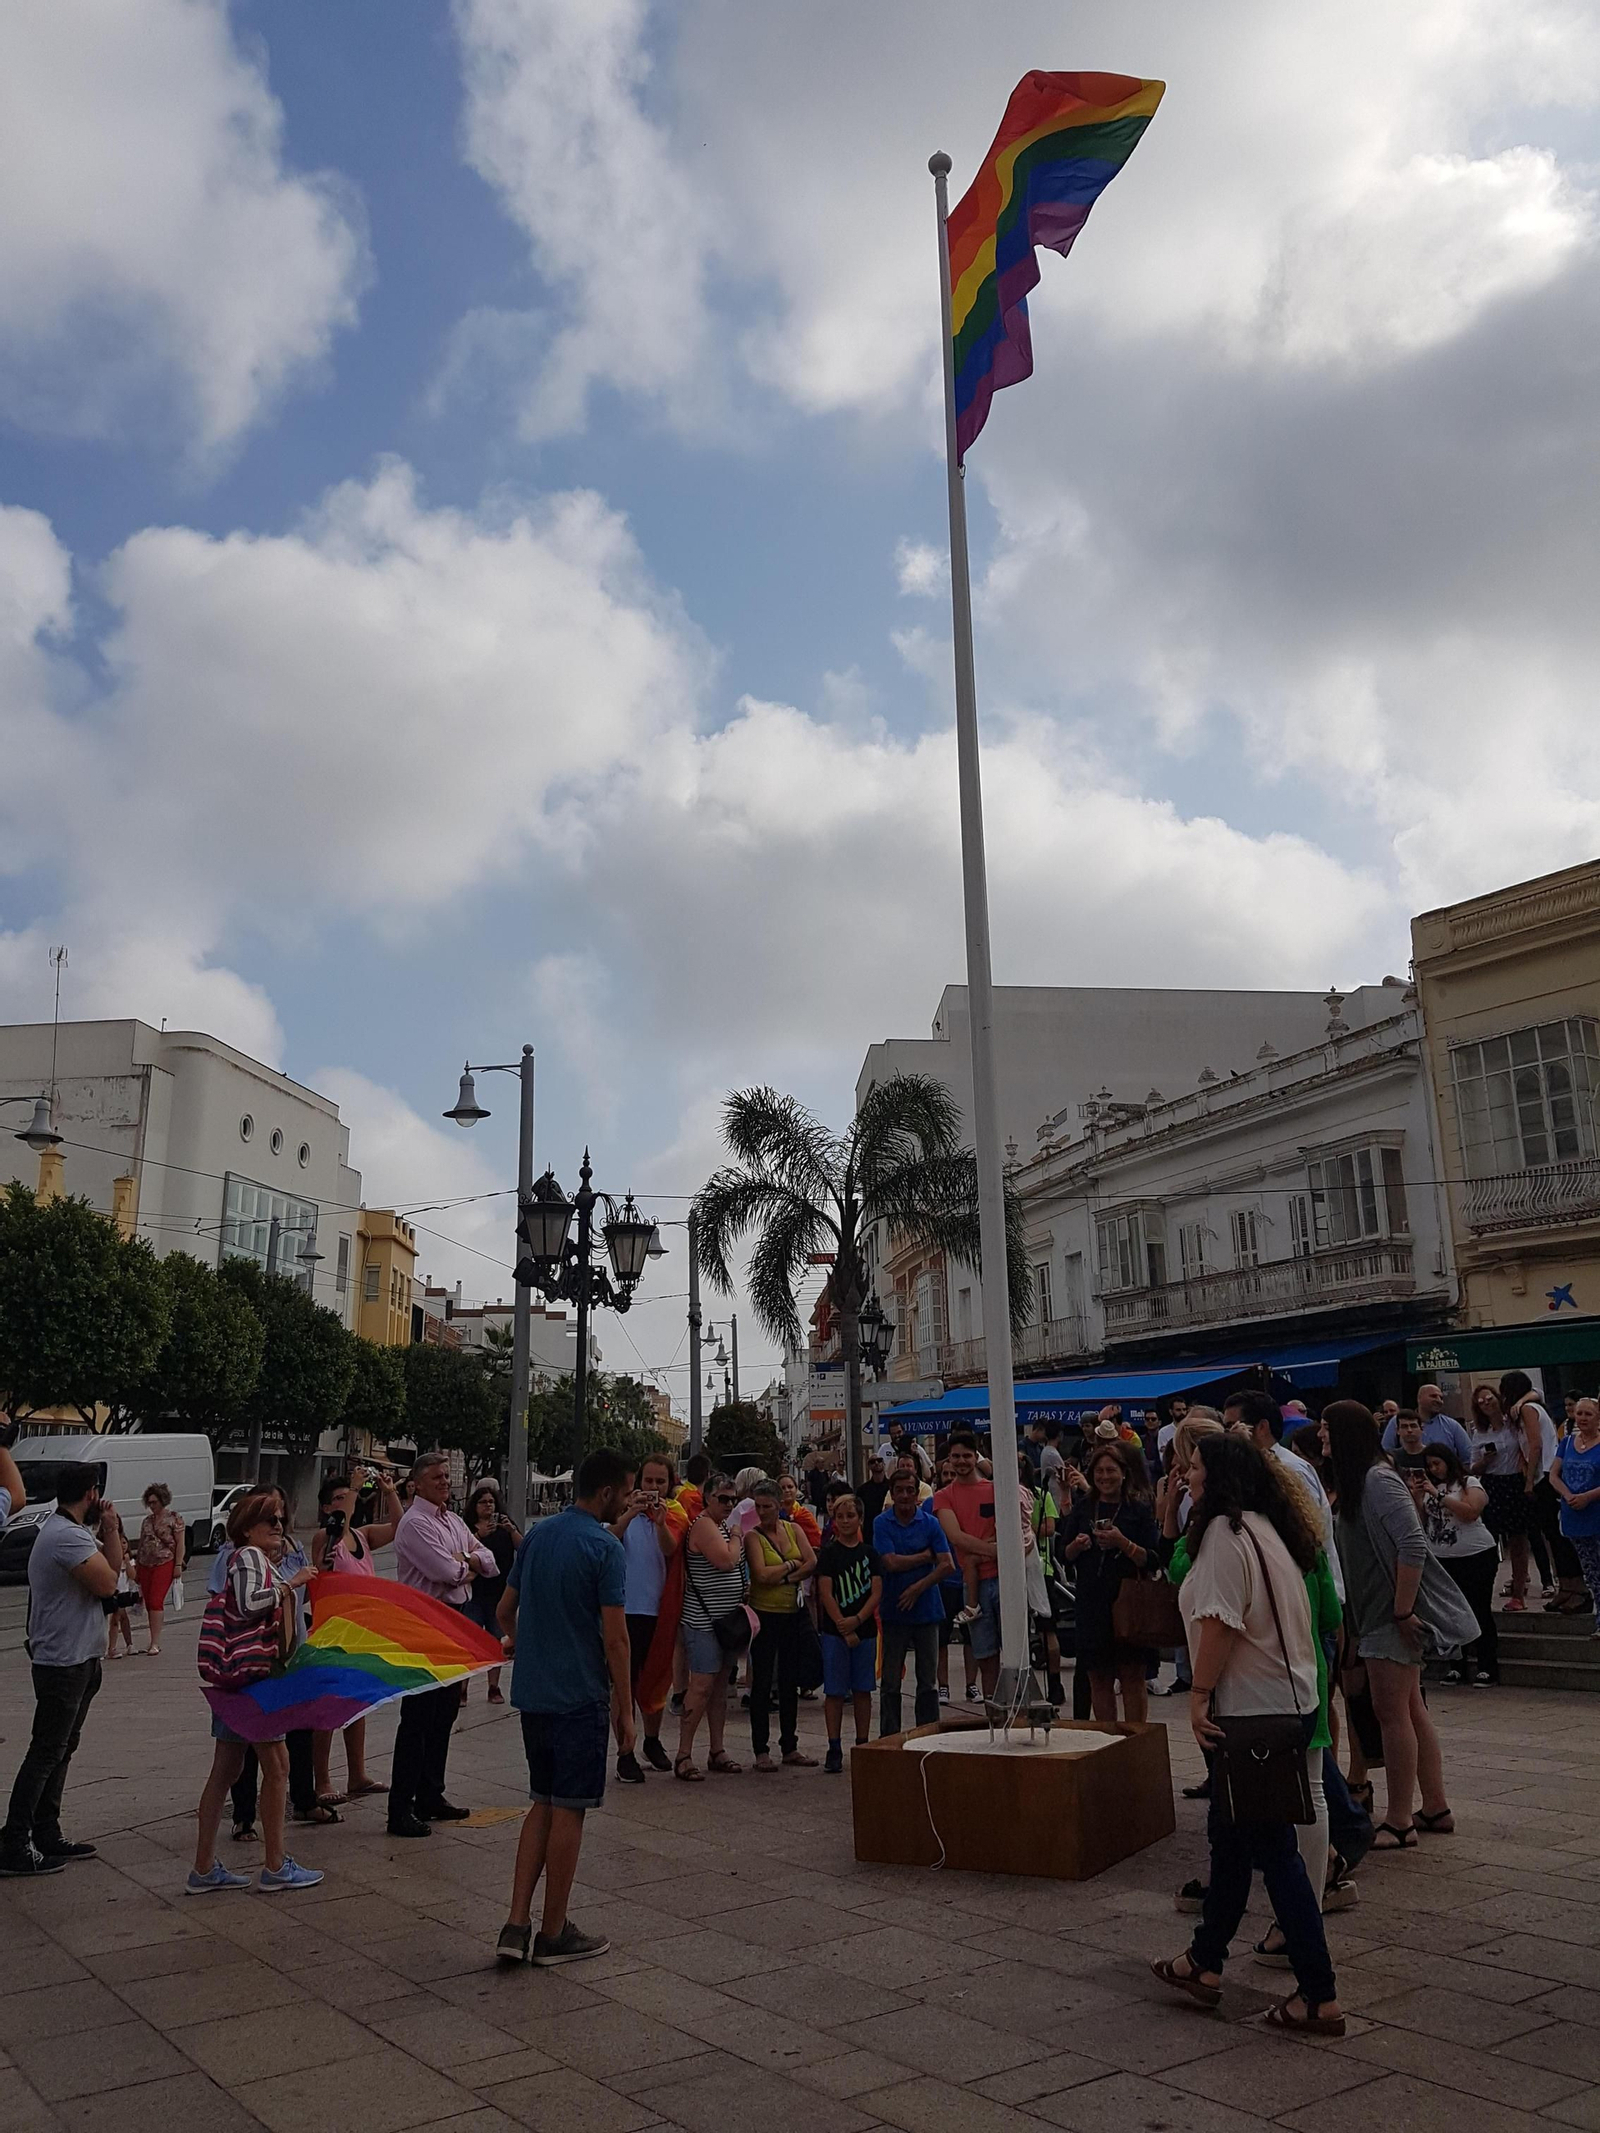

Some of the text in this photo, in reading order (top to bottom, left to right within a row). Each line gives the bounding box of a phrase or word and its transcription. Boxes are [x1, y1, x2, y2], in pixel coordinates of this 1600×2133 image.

[1027, 1410, 1056, 1421] TAPAS
[1058, 1410, 1066, 1421] Y
[935, 1420, 942, 1431] Y
